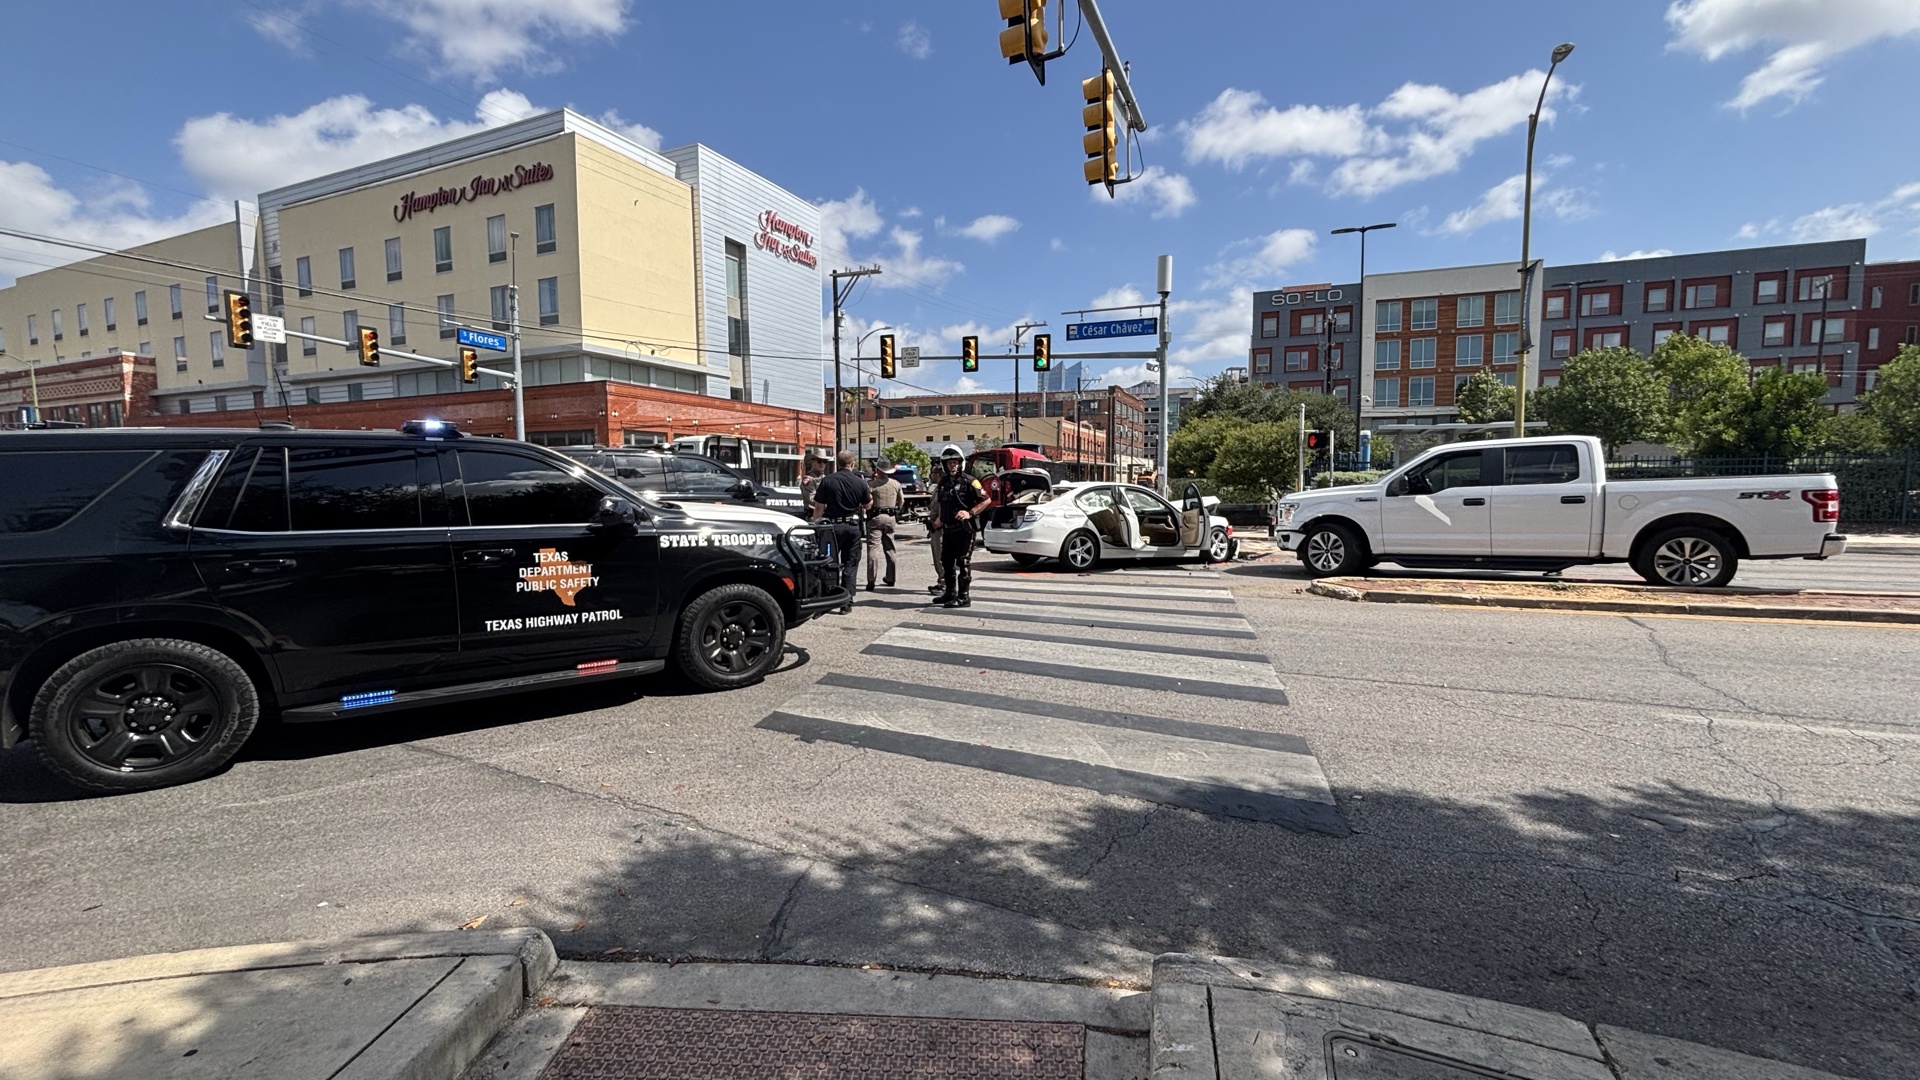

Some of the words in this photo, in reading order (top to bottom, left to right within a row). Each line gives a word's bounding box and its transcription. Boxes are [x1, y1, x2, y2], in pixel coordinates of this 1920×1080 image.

[393, 187, 462, 223] Hampton
[462, 174, 501, 202] Inn
[501, 175, 512, 192] &
[509, 161, 554, 189] Suites
[758, 210, 813, 249] Hampton
[754, 231, 782, 258] Inn
[789, 243, 817, 270] Suites
[1082, 325, 1107, 336] César
[1110, 322, 1143, 334] Chávez
[469, 332, 500, 346] Flores
[1737, 490, 1791, 500] STX
[659, 534, 708, 548] STATE
[711, 533, 774, 547] TROOPER
[533, 551, 569, 563] TEXAS
[518, 563, 593, 578] DEPARTMENT
[516, 581, 557, 593] PUBLIC
[559, 576, 600, 589] SAFETY
[485, 618, 523, 632] TEXAS
[525, 613, 579, 629] HIGHWAY
[581, 609, 623, 623] PATROL
